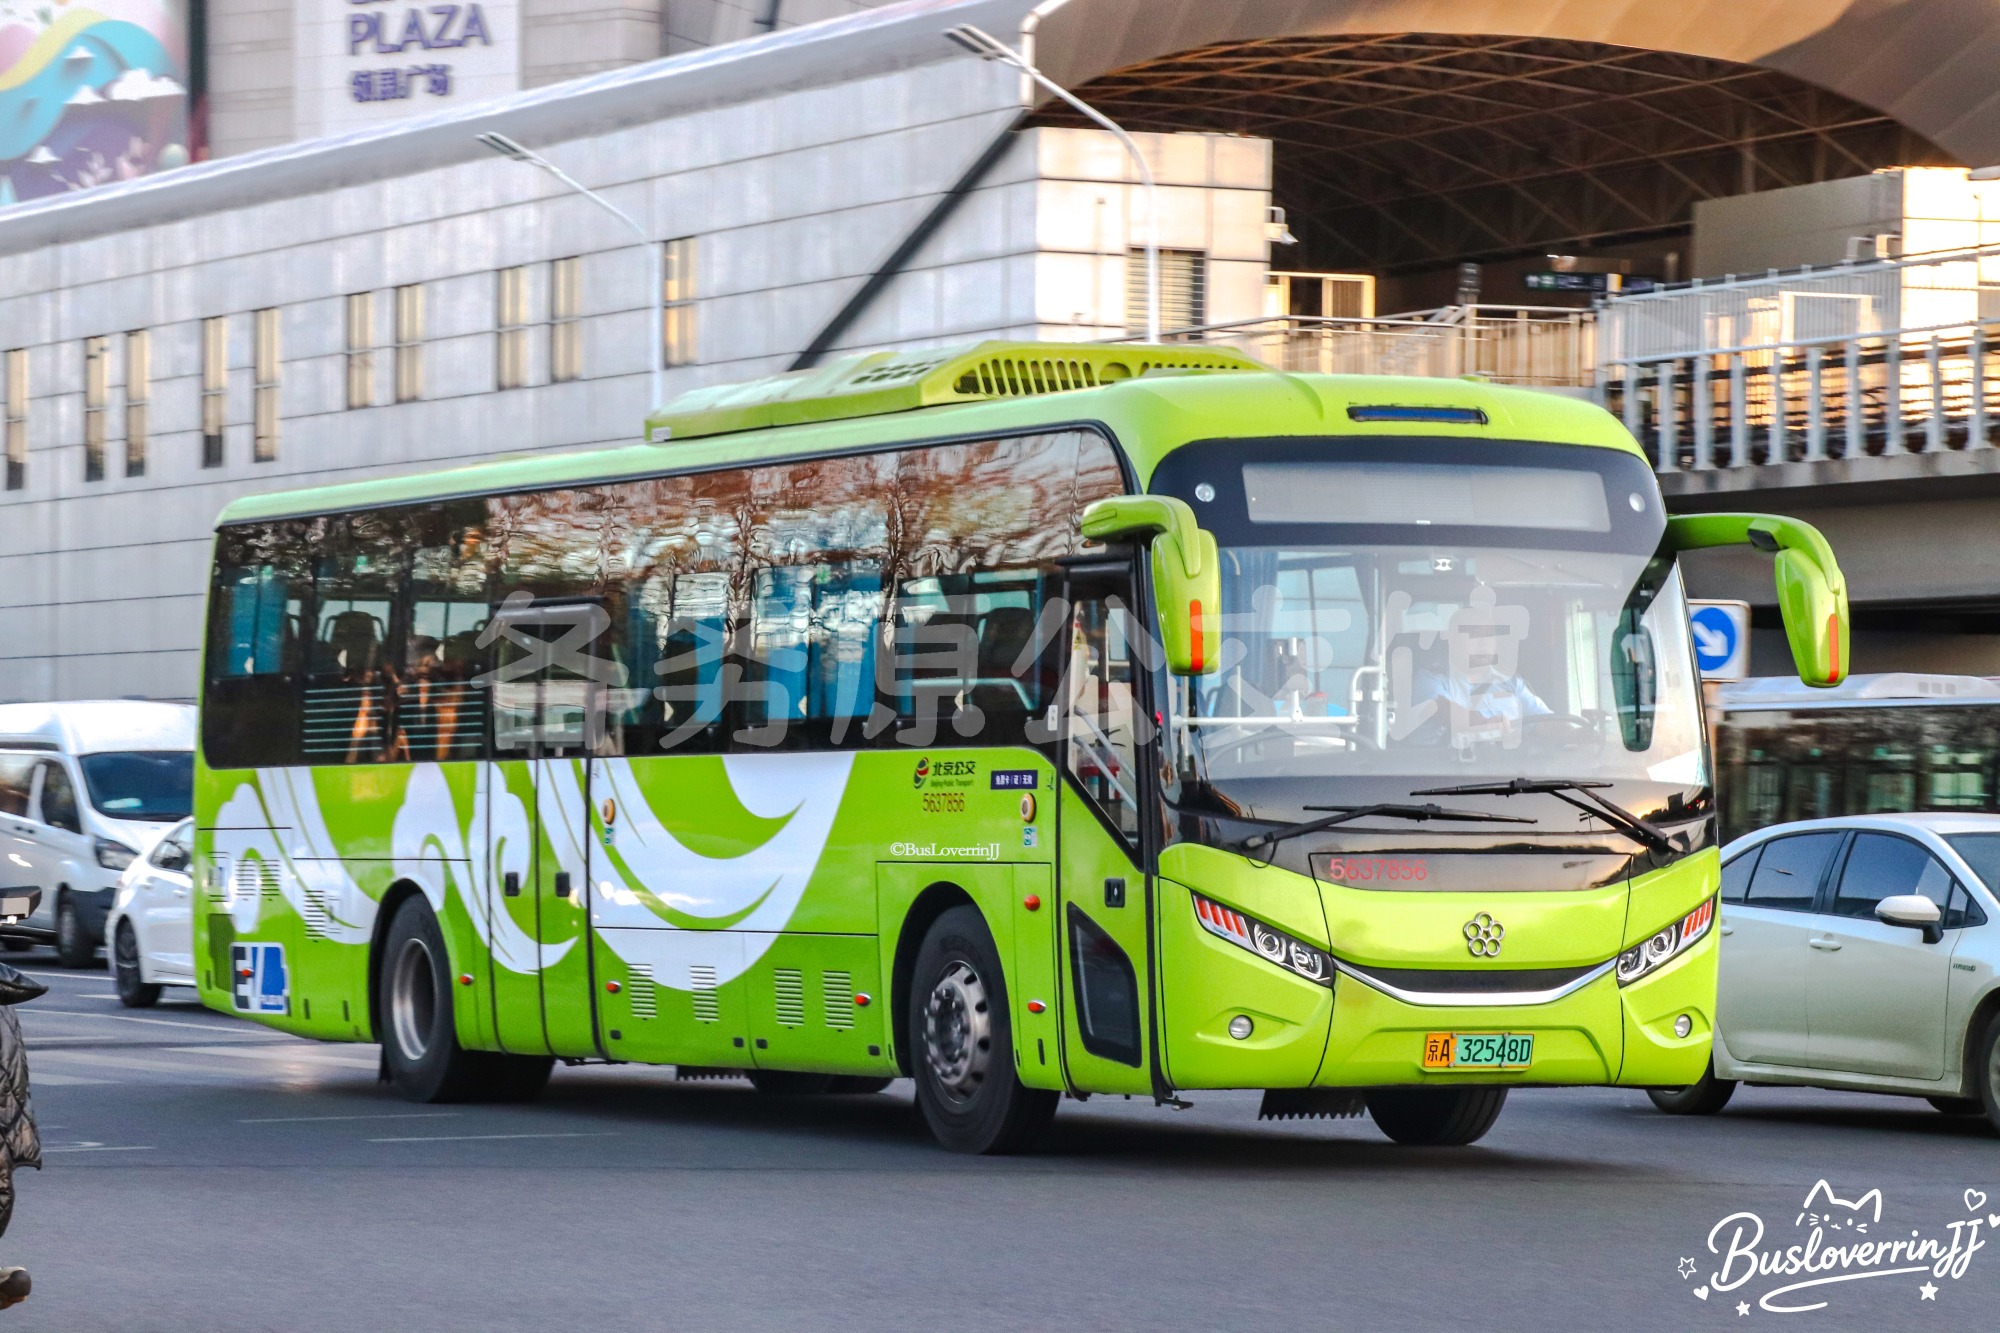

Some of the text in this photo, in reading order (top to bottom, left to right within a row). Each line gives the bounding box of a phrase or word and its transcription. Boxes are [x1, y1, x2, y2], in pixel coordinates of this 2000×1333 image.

[349, 3, 491, 55] PLAZA
[932, 760, 976, 776] 北京公交
[922, 792, 965, 812] 5637856
[1329, 858, 1428, 881] 5637856
